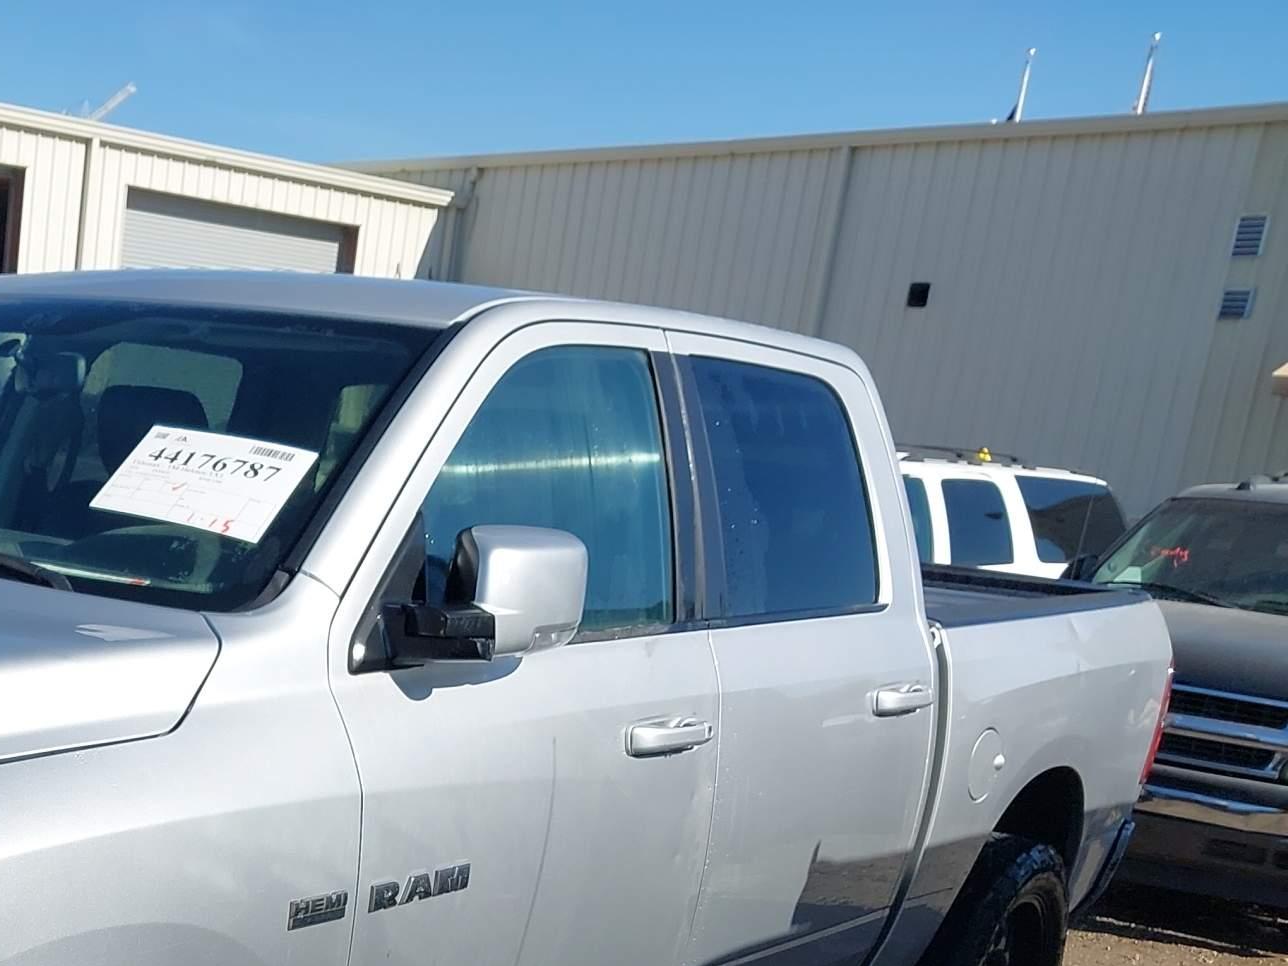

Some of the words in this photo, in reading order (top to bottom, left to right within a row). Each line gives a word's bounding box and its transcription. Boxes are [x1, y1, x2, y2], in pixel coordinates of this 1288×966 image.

[148, 447, 282, 482] 44176787
[290, 890, 349, 918] HEMI
[367, 860, 471, 914] RAM
